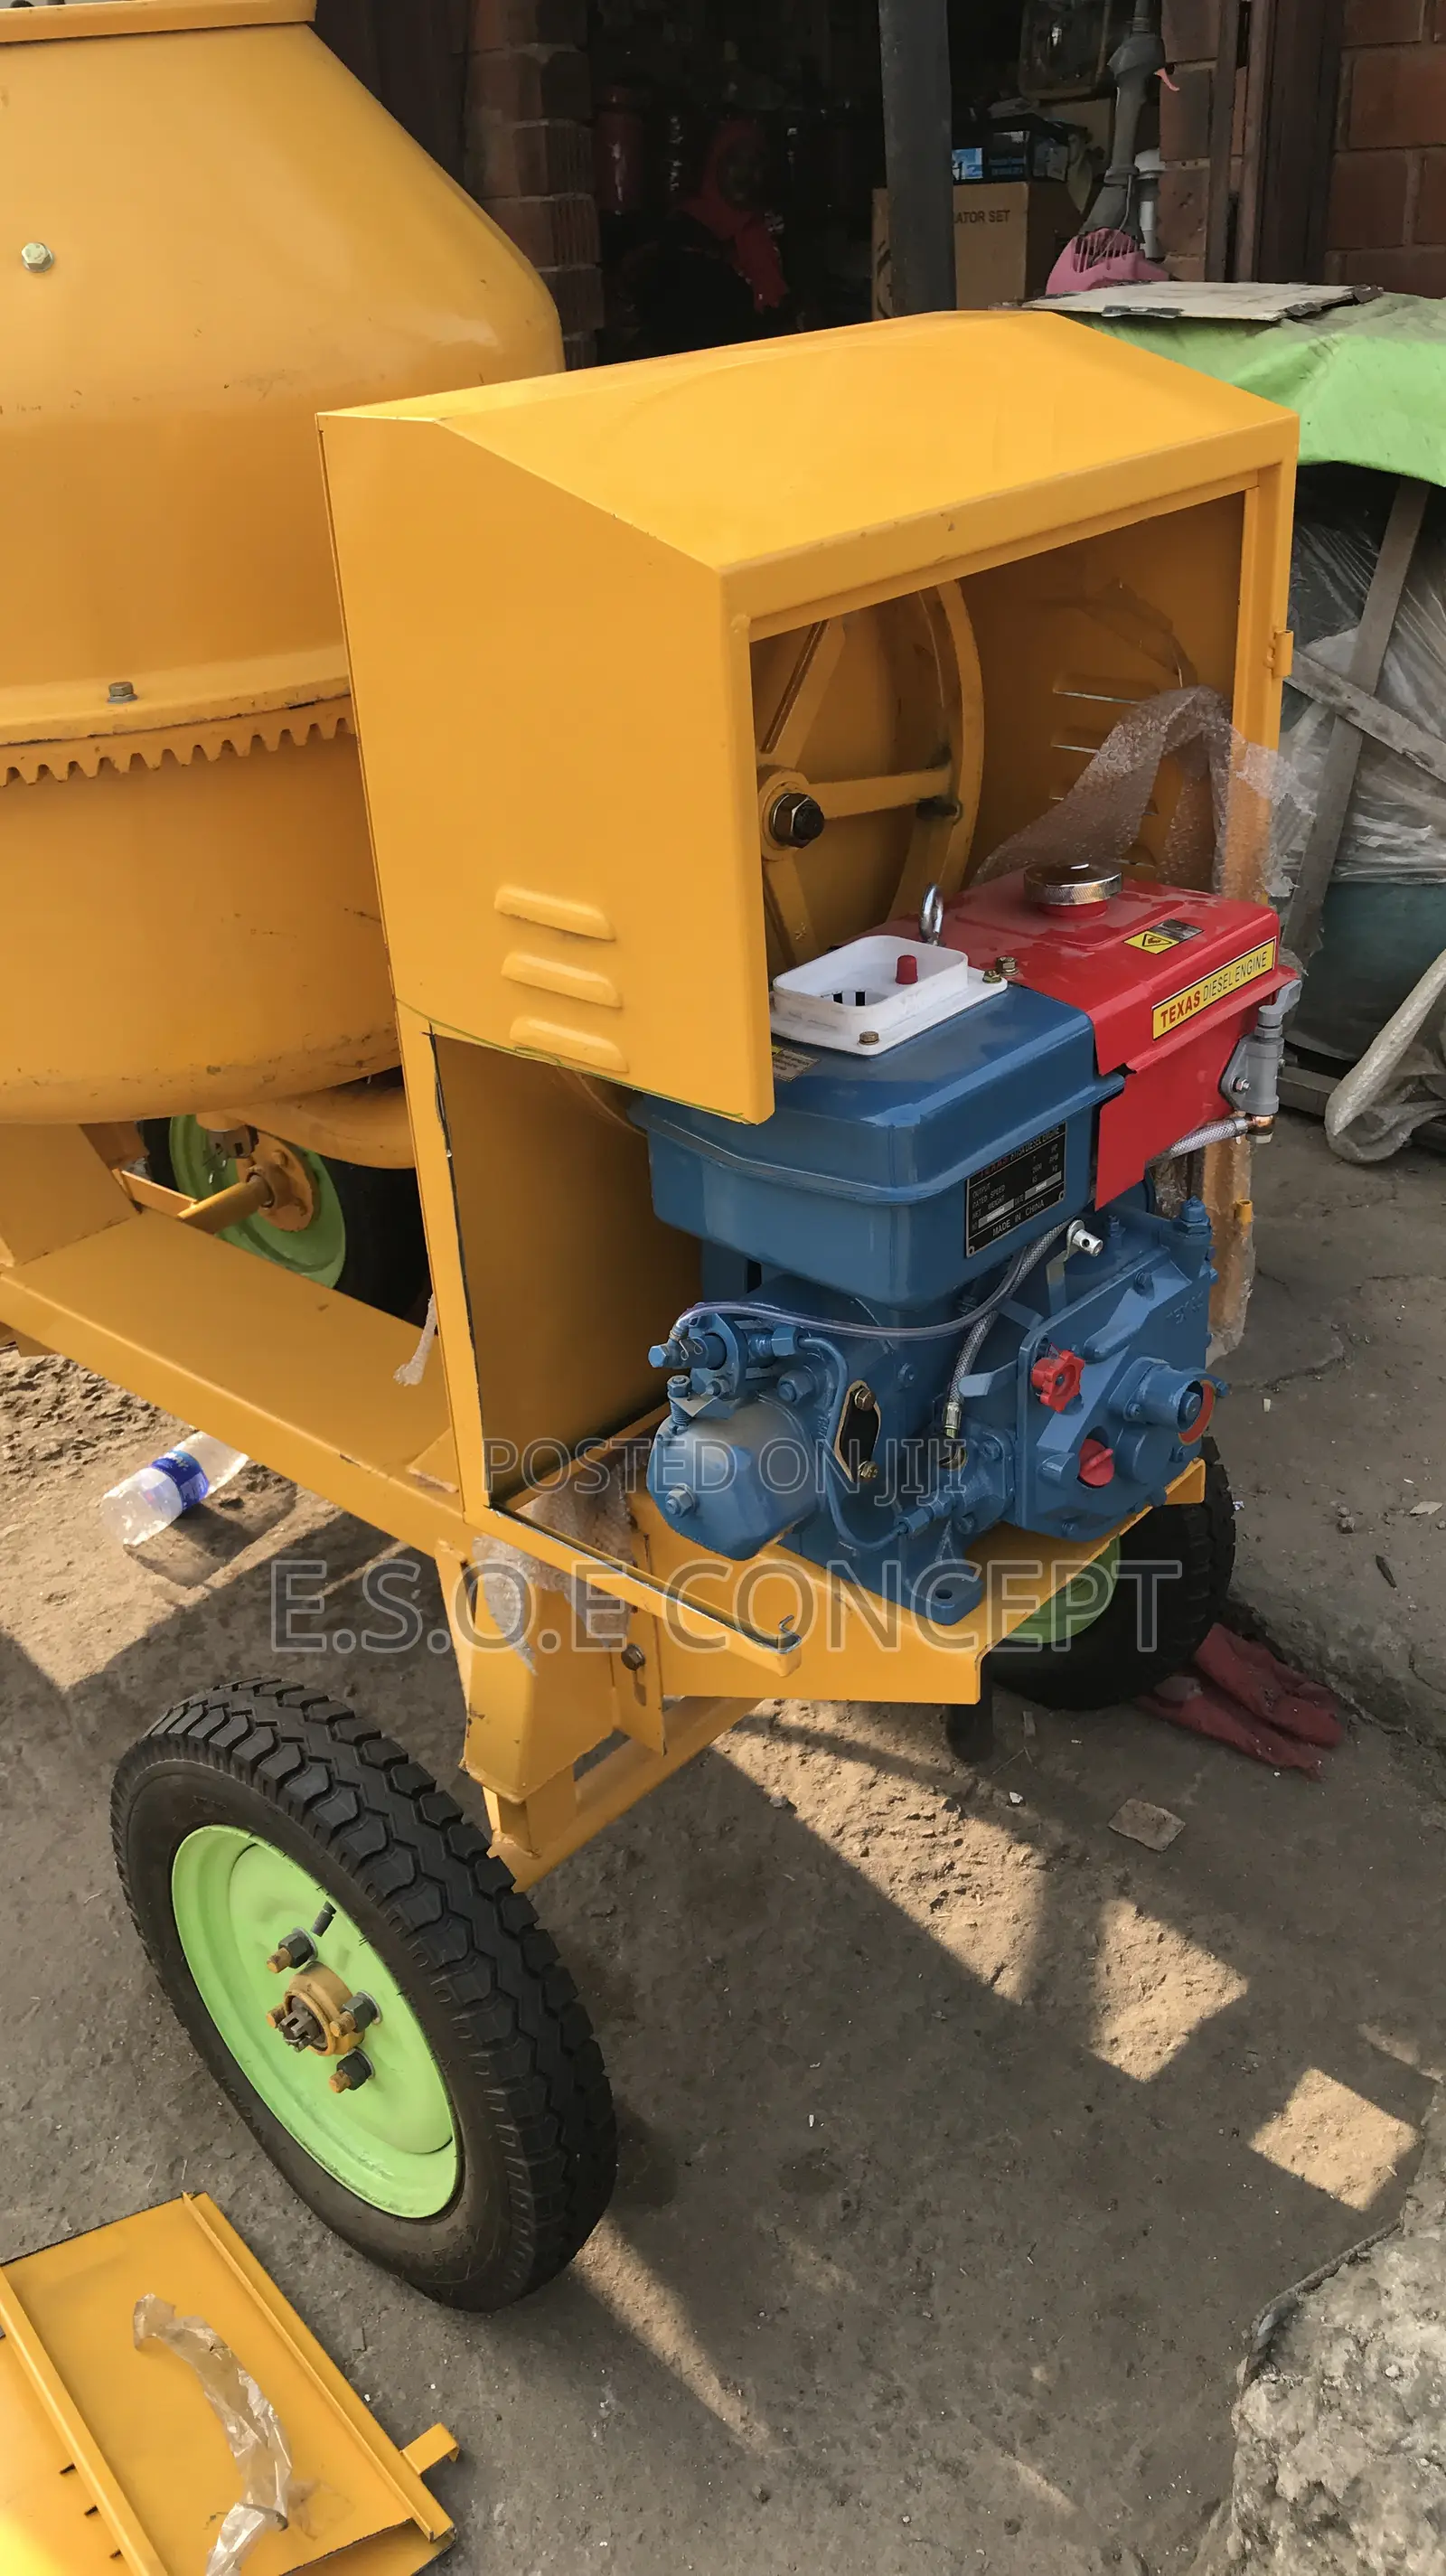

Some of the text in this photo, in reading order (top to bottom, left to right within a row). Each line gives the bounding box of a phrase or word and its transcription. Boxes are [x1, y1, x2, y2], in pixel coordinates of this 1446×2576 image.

[953, 210, 1010, 223] ATOR SET
[1160, 951, 1267, 1029] TEXAS DIESEL ENGINE
[992, 1218, 1011, 1237] MADE
[1015, 1212, 1022, 1223] IN
[1025, 1199, 1045, 1217] CHINA
